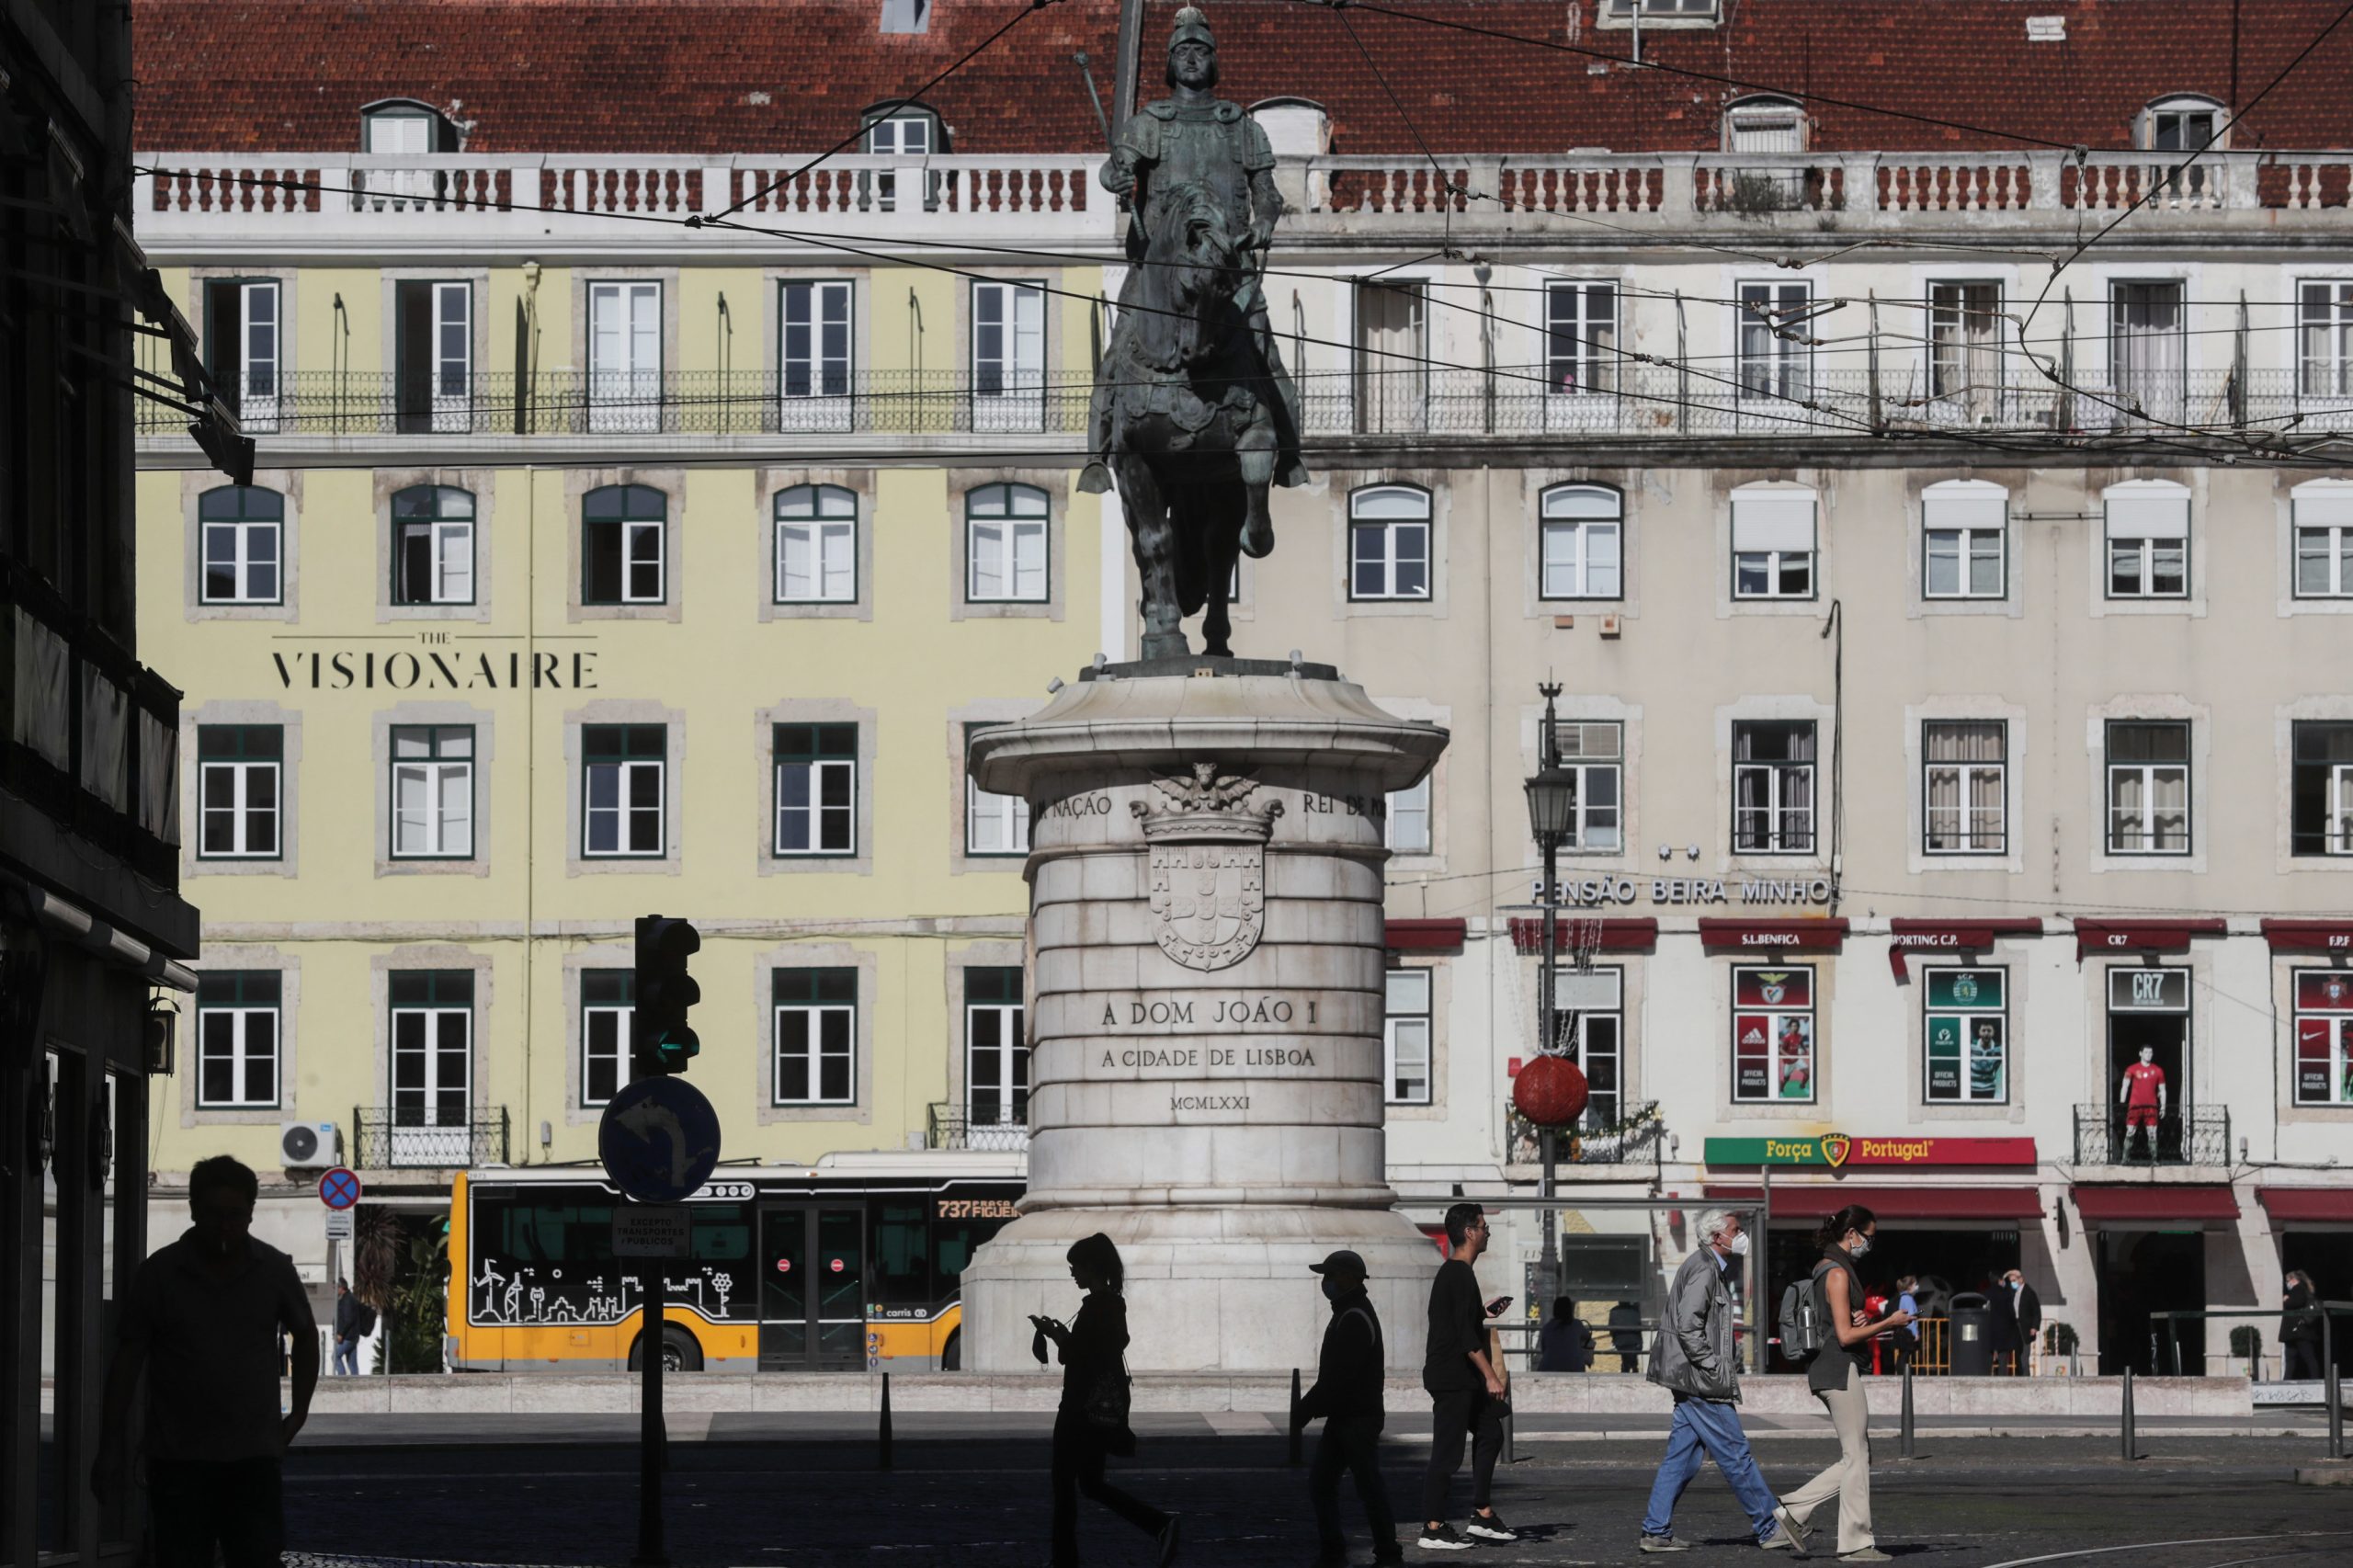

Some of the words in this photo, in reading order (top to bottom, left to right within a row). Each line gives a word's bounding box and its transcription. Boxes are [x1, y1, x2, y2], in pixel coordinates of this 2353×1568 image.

[418, 632, 451, 644] THE
[272, 652, 598, 688] VISIONAIRE
[1053, 791, 1112, 820] NAÇÃO
[1302, 793, 1334, 814] REI
[1346, 795, 1365, 816] DE
[1651, 879, 1727, 902] BEIRA
[1741, 879, 1830, 902] MINHO
[1742, 934, 1801, 946] S.L.BENFICA
[2108, 935, 2129, 946] CR7
[2132, 972, 2165, 1000] CR7
[1101, 1002, 1118, 1026] A
[1131, 1001, 1195, 1025] DOM
[1212, 995, 1293, 1024] JOÃO
[1308, 1001, 1317, 1025] I
[1102, 1050, 1116, 1067] A
[1121, 1049, 1199, 1067] CIDADE
[1210, 1049, 1236, 1066] DE
[1245, 1048, 1316, 1067] LISBOA
[1170, 1096, 1251, 1111] MCMLXXI
[1766, 1140, 1813, 1163] Força
[938, 1199, 972, 1219] 737
[617, 1227, 685, 1236] TRANSPORTES
[631, 1218, 672, 1227] EXCEPTO
[886, 1308, 913, 1318] carris
